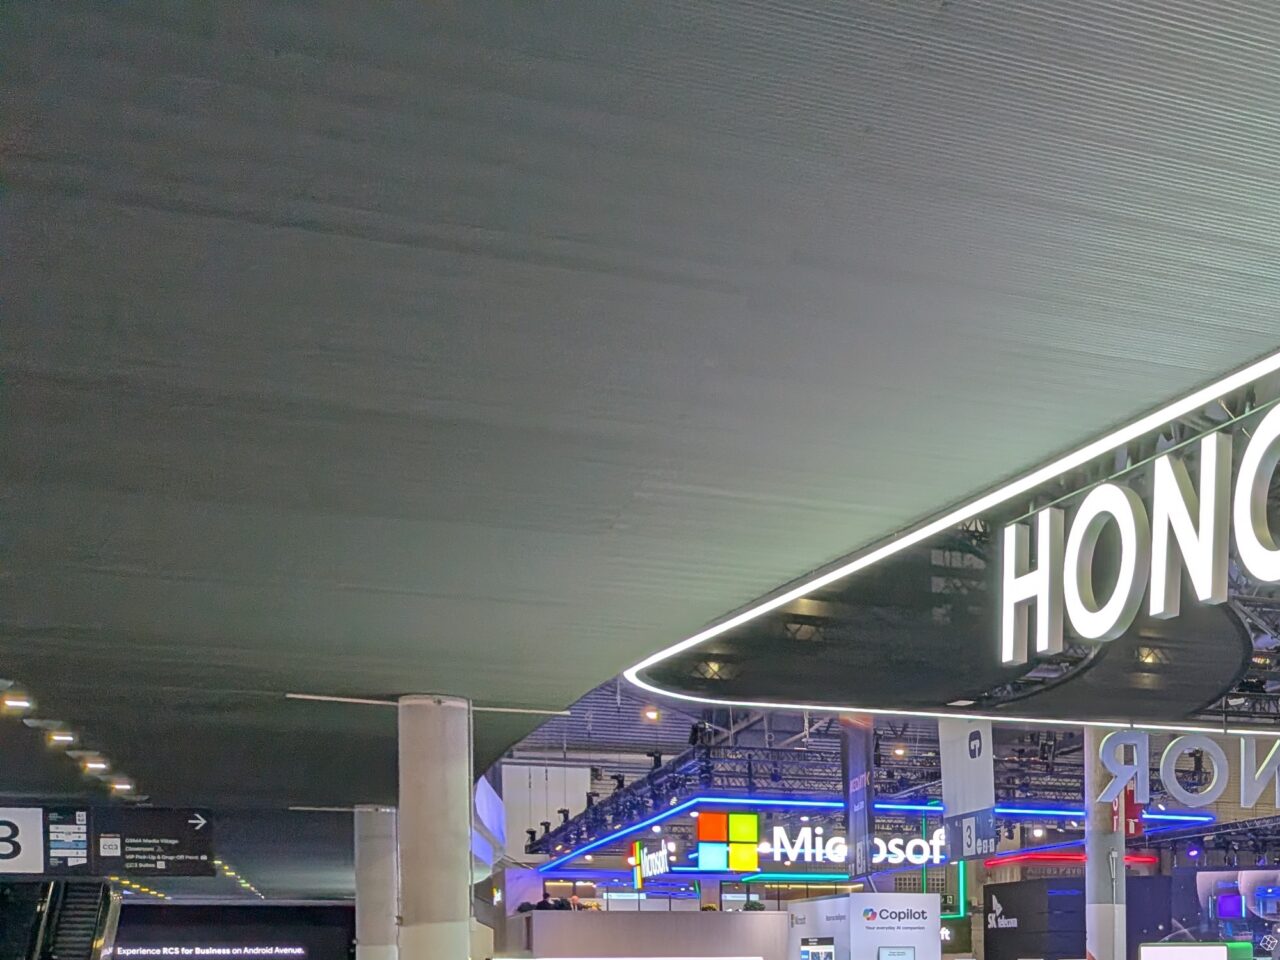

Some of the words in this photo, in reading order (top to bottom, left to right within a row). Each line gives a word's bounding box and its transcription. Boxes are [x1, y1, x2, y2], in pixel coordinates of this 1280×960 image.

[773, 825, 946, 865] Micosof
[966, 825, 973, 849] 3
[640, 840, 670, 878] Microsoft
[878, 909, 928, 922] Copilot
[117, 947, 161, 956] Experience
[162, 947, 180, 955] RCS
[181, 946, 194, 955] for
[195, 947, 231, 955] Business
[243, 946, 273, 955] Android
[274, 947, 305, 955] Avenue.
